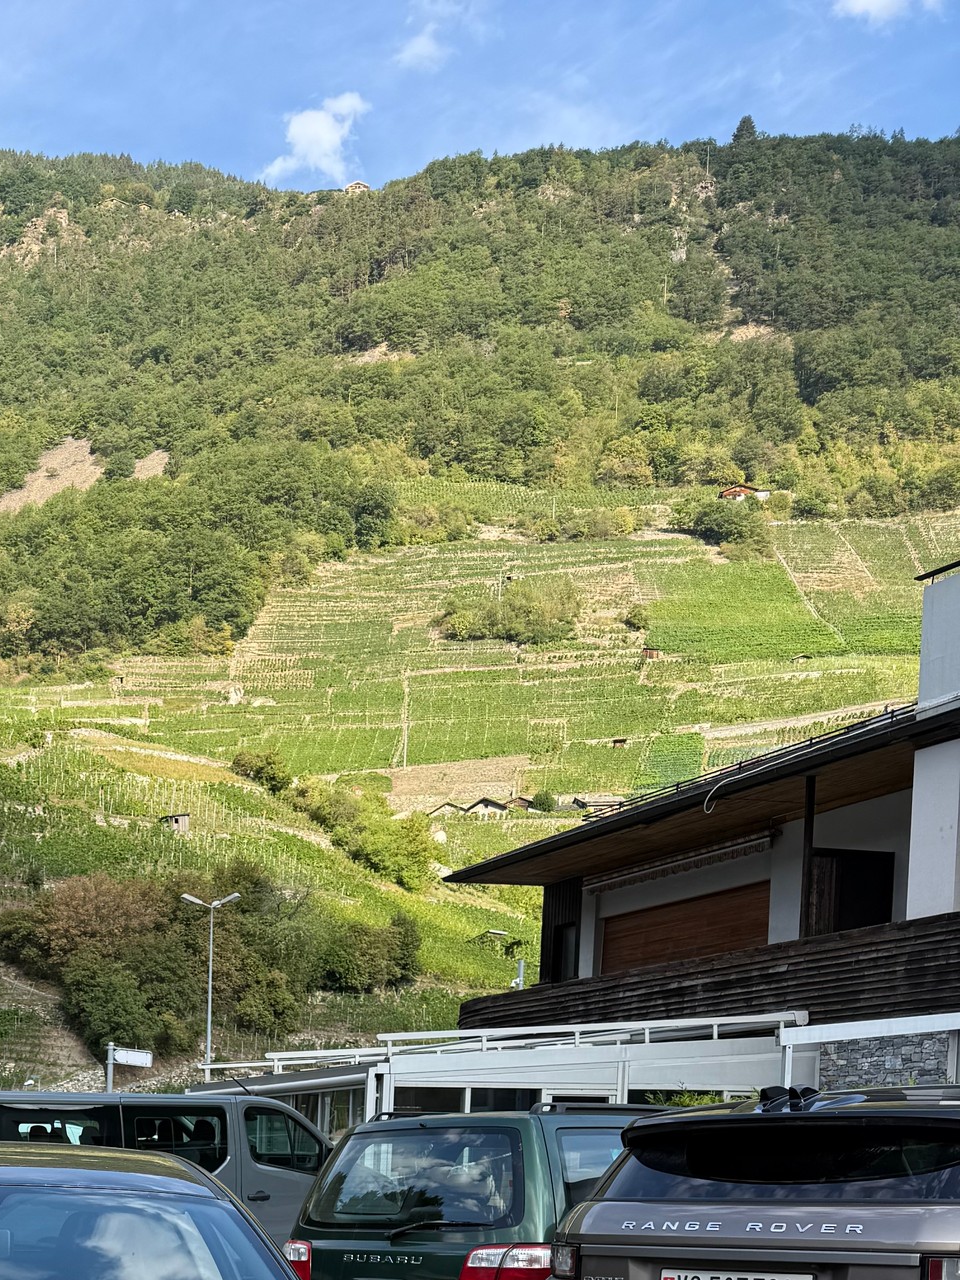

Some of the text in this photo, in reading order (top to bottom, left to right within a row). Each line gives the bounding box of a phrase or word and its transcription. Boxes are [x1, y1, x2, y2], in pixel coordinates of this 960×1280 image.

[621, 1221, 864, 1234] RANGE ROVER
[343, 1253, 423, 1264] SUBARU
